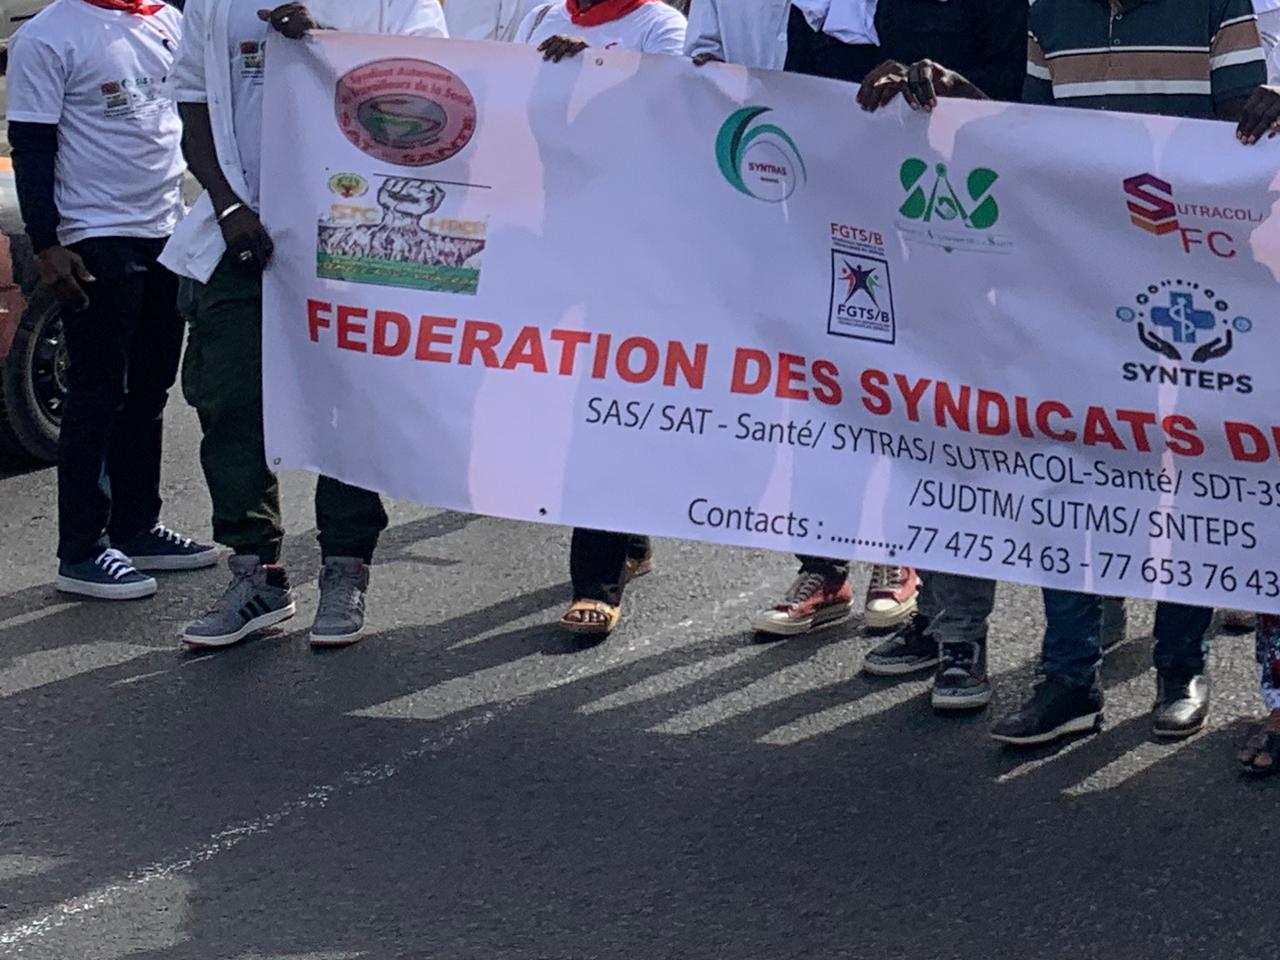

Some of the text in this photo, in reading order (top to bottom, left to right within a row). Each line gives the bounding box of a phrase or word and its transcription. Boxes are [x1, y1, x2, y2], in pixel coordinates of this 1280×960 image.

[898, 157, 999, 230] SAS
[831, 222, 884, 246] FGTS/B
[1179, 227, 1236, 258] FC
[837, 303, 890, 323] FGTS/B
[306, 299, 709, 390] FEDERATION
[730, 347, 843, 406] DES
[860, 369, 1205, 458] SYNDICATS
[1122, 362, 1253, 394] SYNTEPS
[586, 396, 654, 431] SAS/
[660, 404, 712, 435] SAT
[735, 413, 826, 450] Santé/
[832, 423, 934, 465] SYTRAS/
[943, 442, 1183, 496] SUTRACOL-Santé/
[688, 498, 809, 540] Contacts
[945, 531, 993, 563] 475
[1001, 539, 1033, 568] 24
[1040, 546, 1071, 574] 63
[1098, 552, 1132, 581] 77
[1141, 557, 1193, 587] 653
[1202, 562, 1237, 592] 76
[1245, 569, 1280, 597] 43
[909, 479, 1257, 549] /SUDTM/ SUTMS/ SNTEPS
